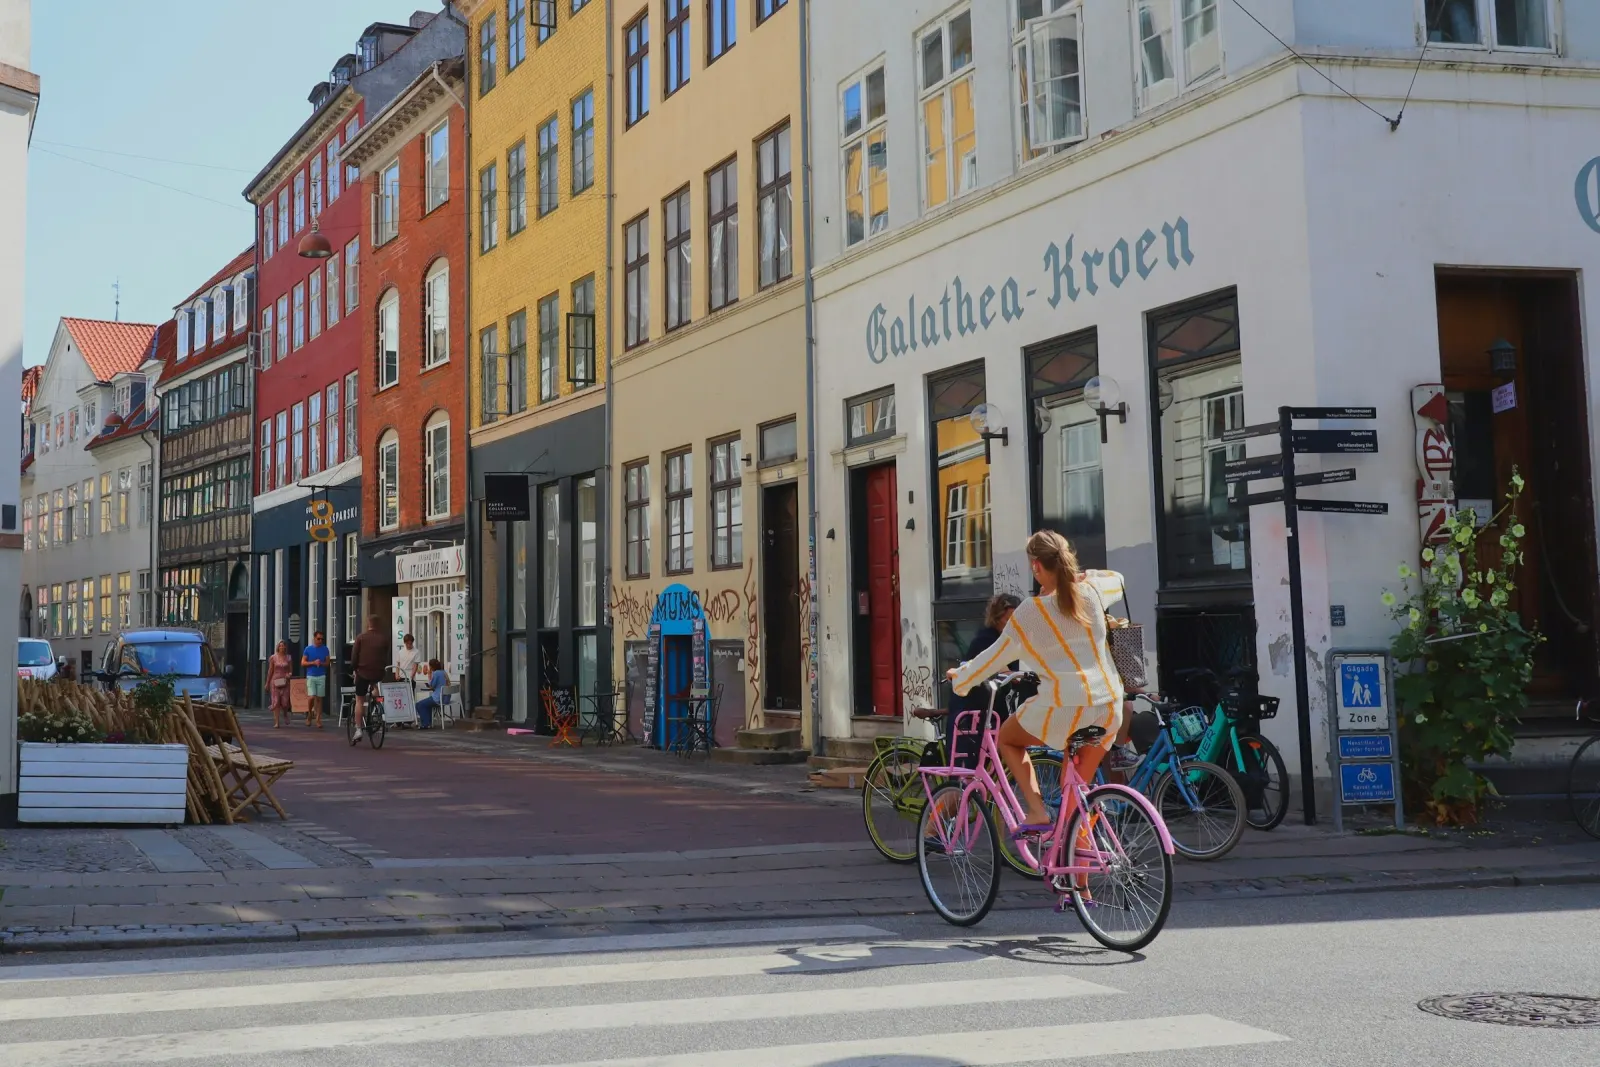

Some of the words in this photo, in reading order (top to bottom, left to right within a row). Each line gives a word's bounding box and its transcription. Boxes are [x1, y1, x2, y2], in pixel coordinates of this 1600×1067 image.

[410, 562, 439, 578] ITALIANO
[656, 590, 700, 621] MUMS
[456, 593, 465, 671] SANDWICH
[1346, 665, 1374, 673] Gågade
[1349, 713, 1377, 723] Zone
[1200, 728, 1217, 756] IER
